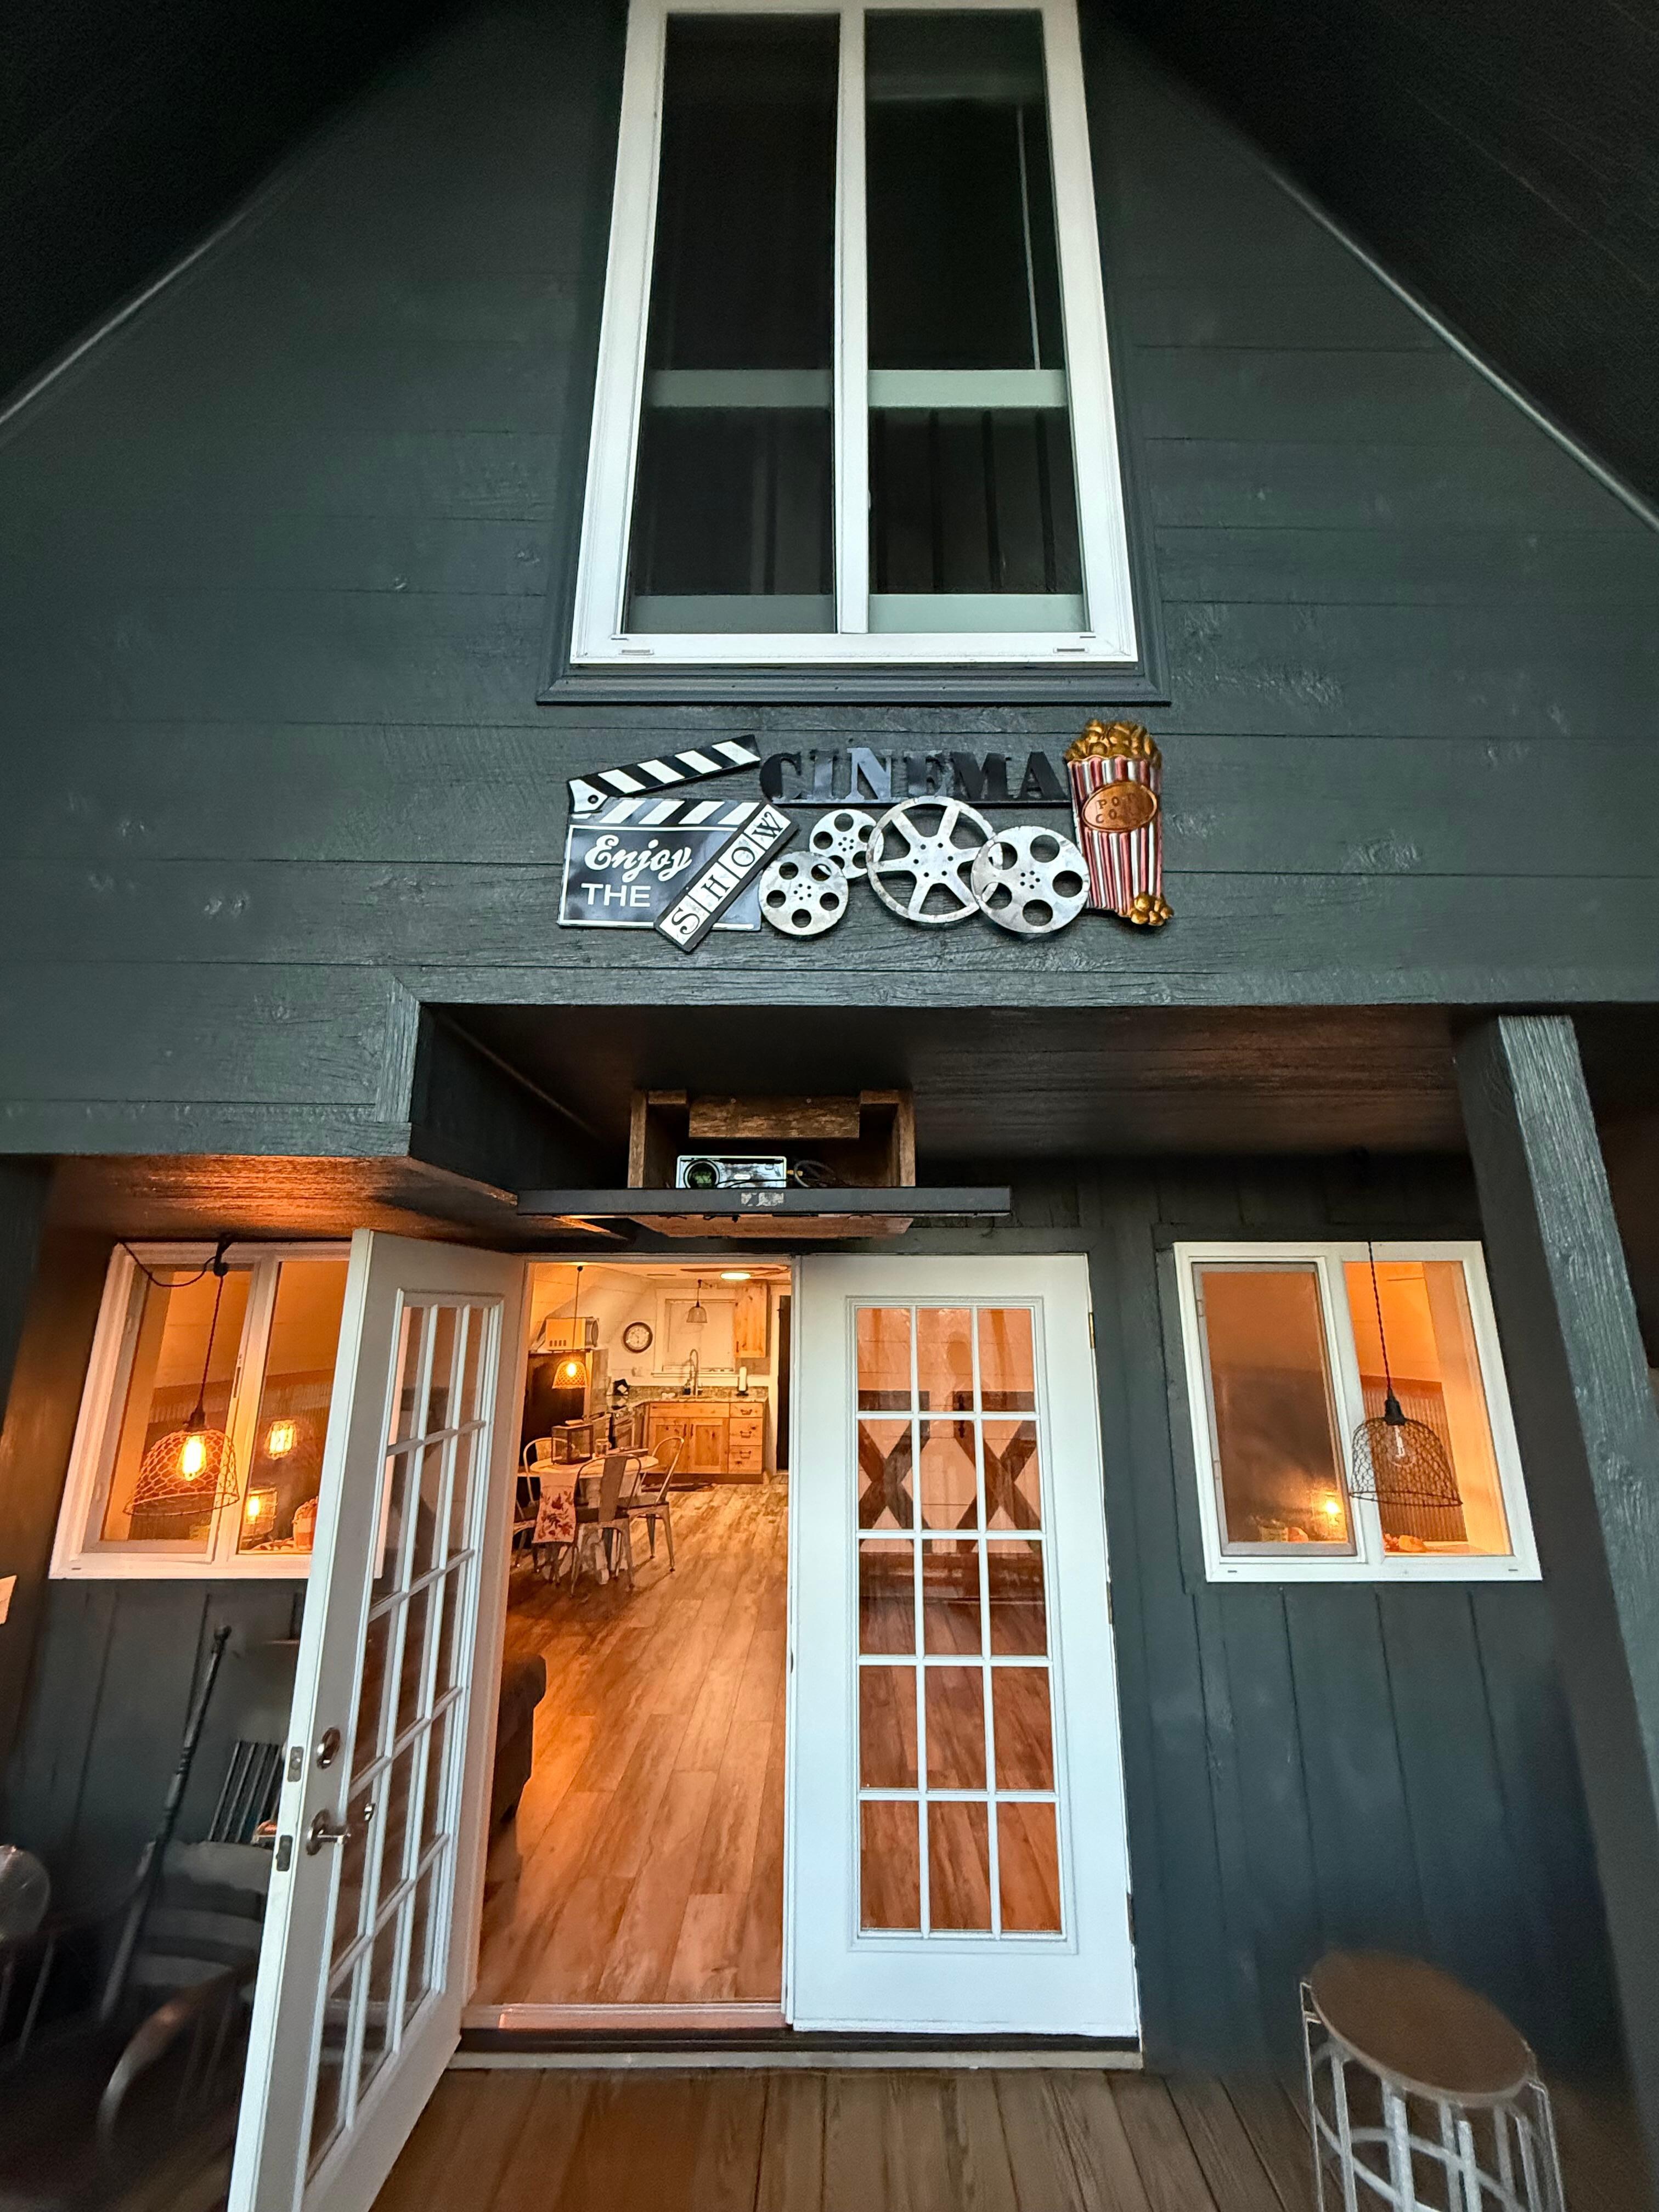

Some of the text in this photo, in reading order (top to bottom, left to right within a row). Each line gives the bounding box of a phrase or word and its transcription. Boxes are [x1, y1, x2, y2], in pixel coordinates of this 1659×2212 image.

[760, 748, 1068, 801] CINEMA
[585, 836, 692, 881] Enjoy
[672, 811, 783, 935] SHOW
[582, 884, 651, 907] THE
